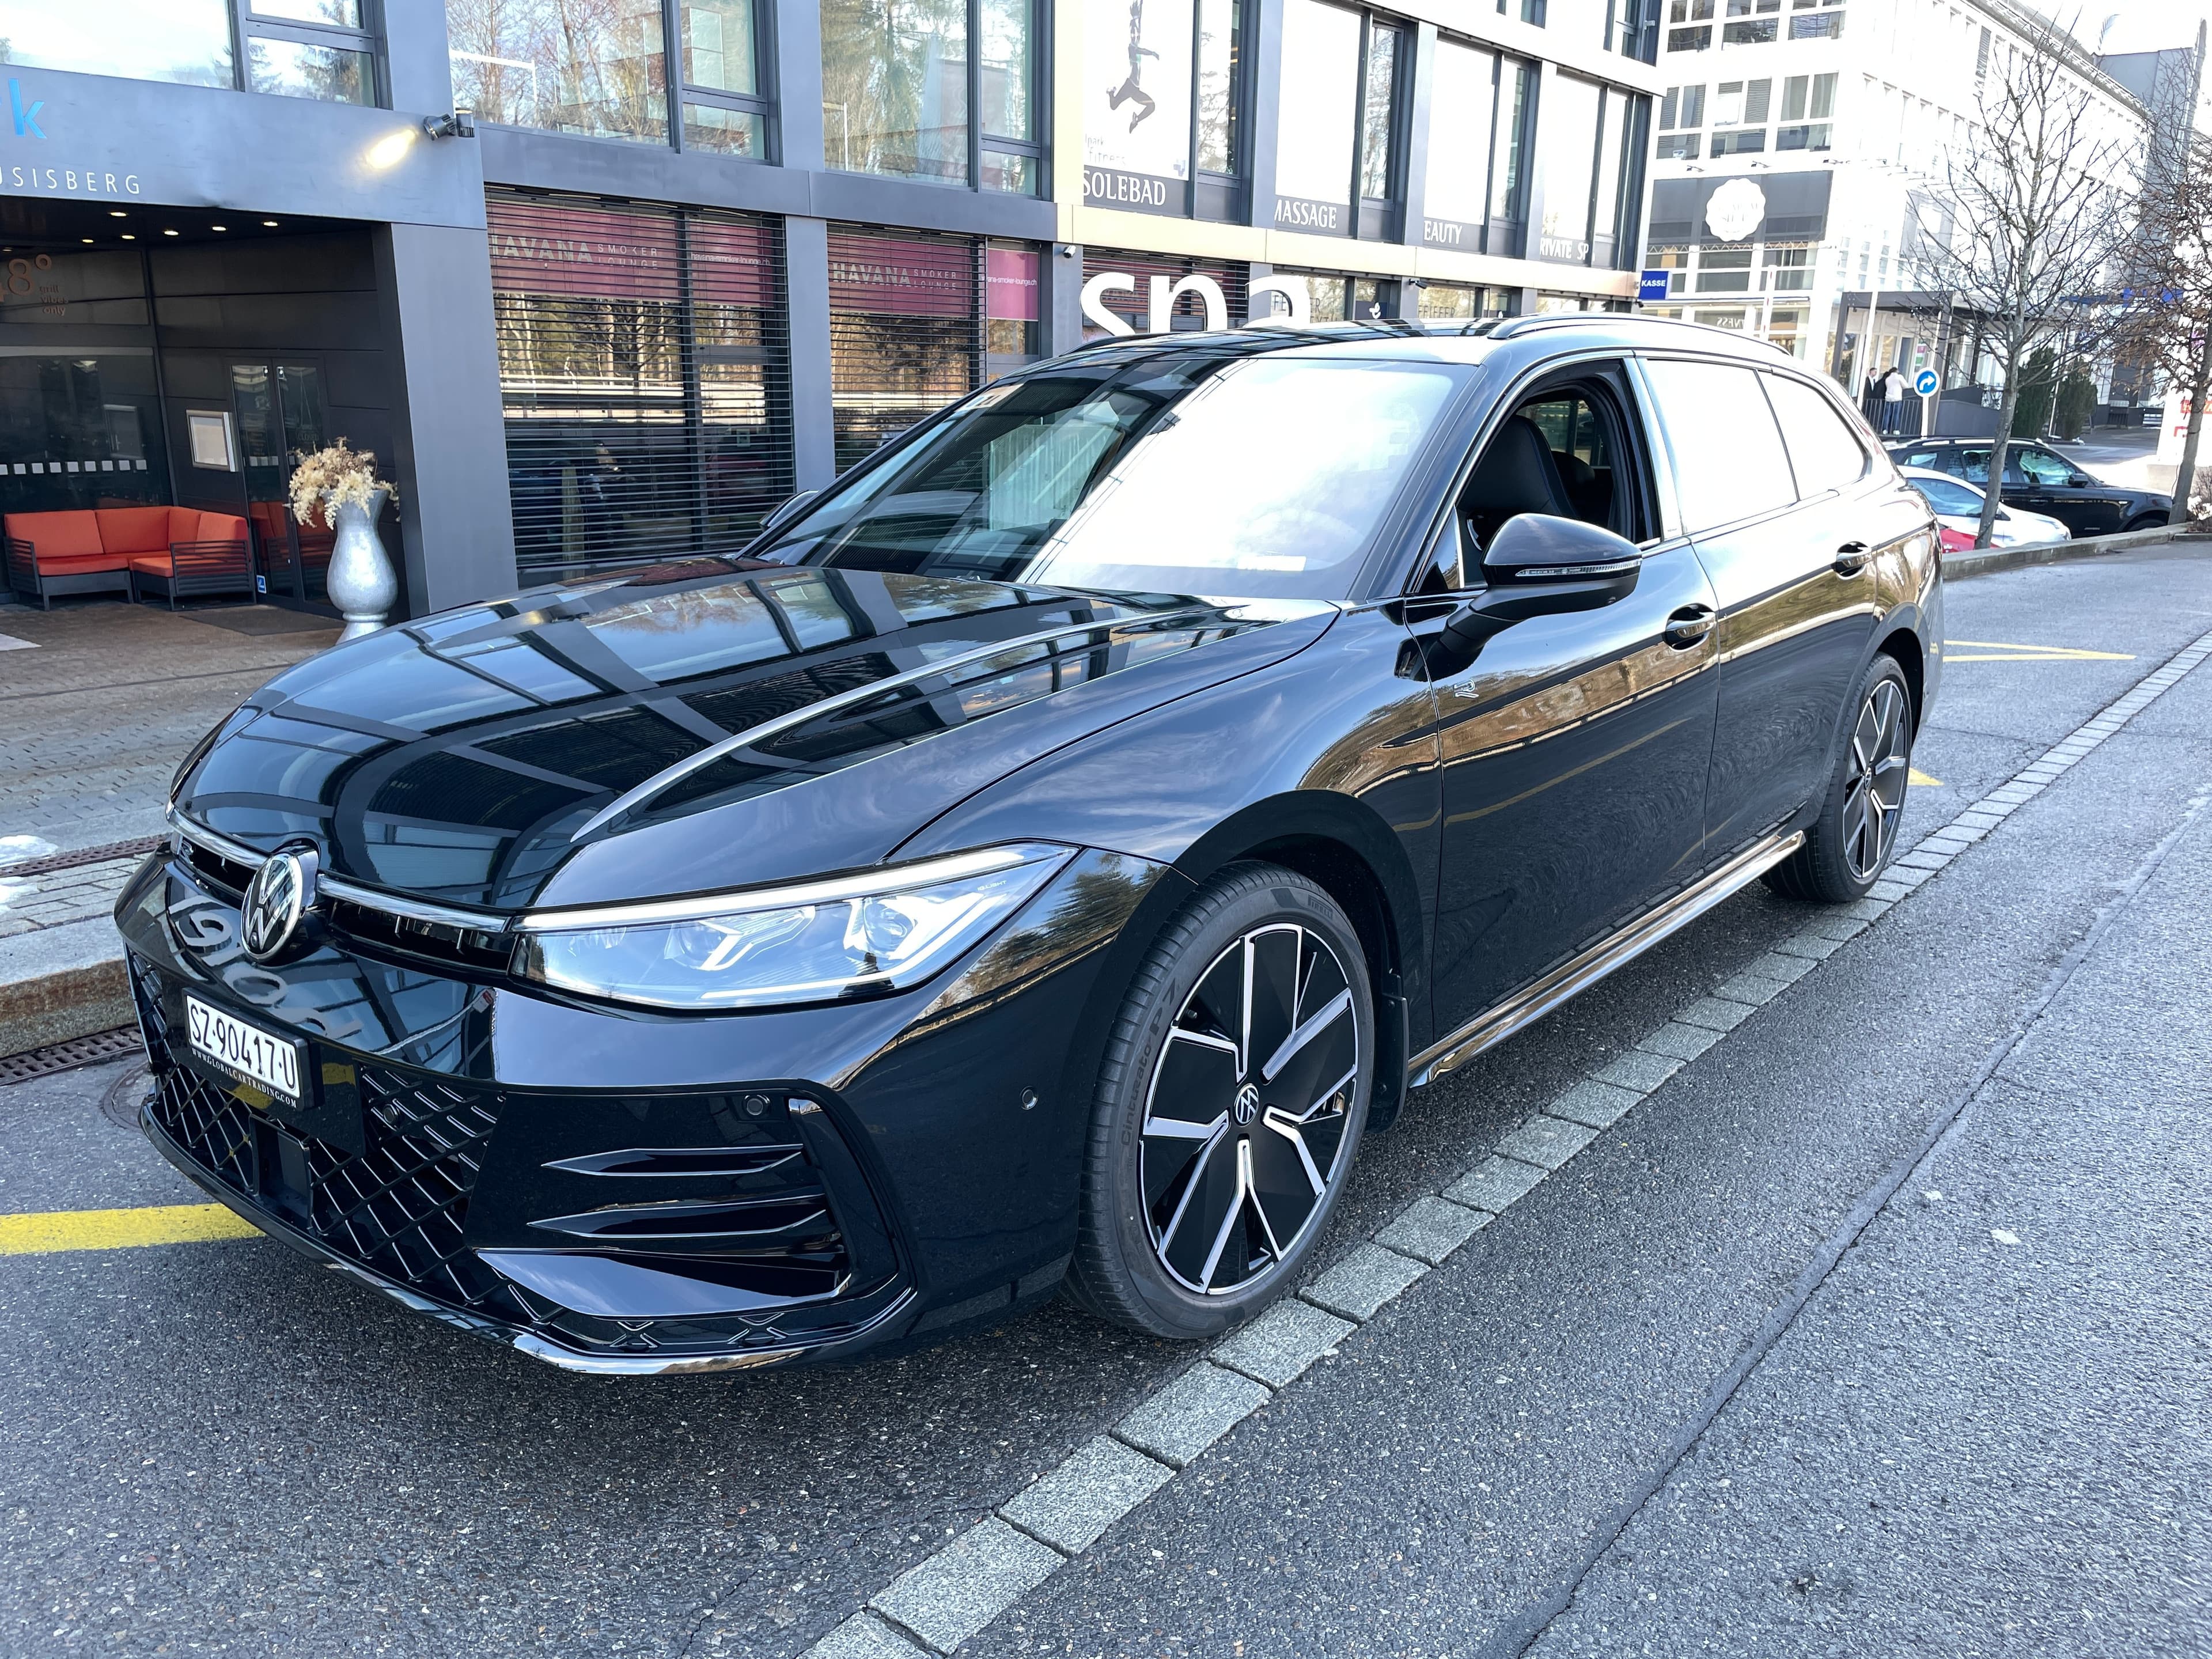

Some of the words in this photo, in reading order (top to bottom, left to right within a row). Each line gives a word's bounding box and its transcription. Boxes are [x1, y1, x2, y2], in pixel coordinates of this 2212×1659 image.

[1084, 170, 1166, 206] SOLEBAD
[1577, 242, 1595, 262] SP
[832, 262, 912, 287] HAVANA
[914, 268, 957, 279] SMOKER
[1641, 279, 1666, 287] KASSE
[42, 305, 66, 317] only
